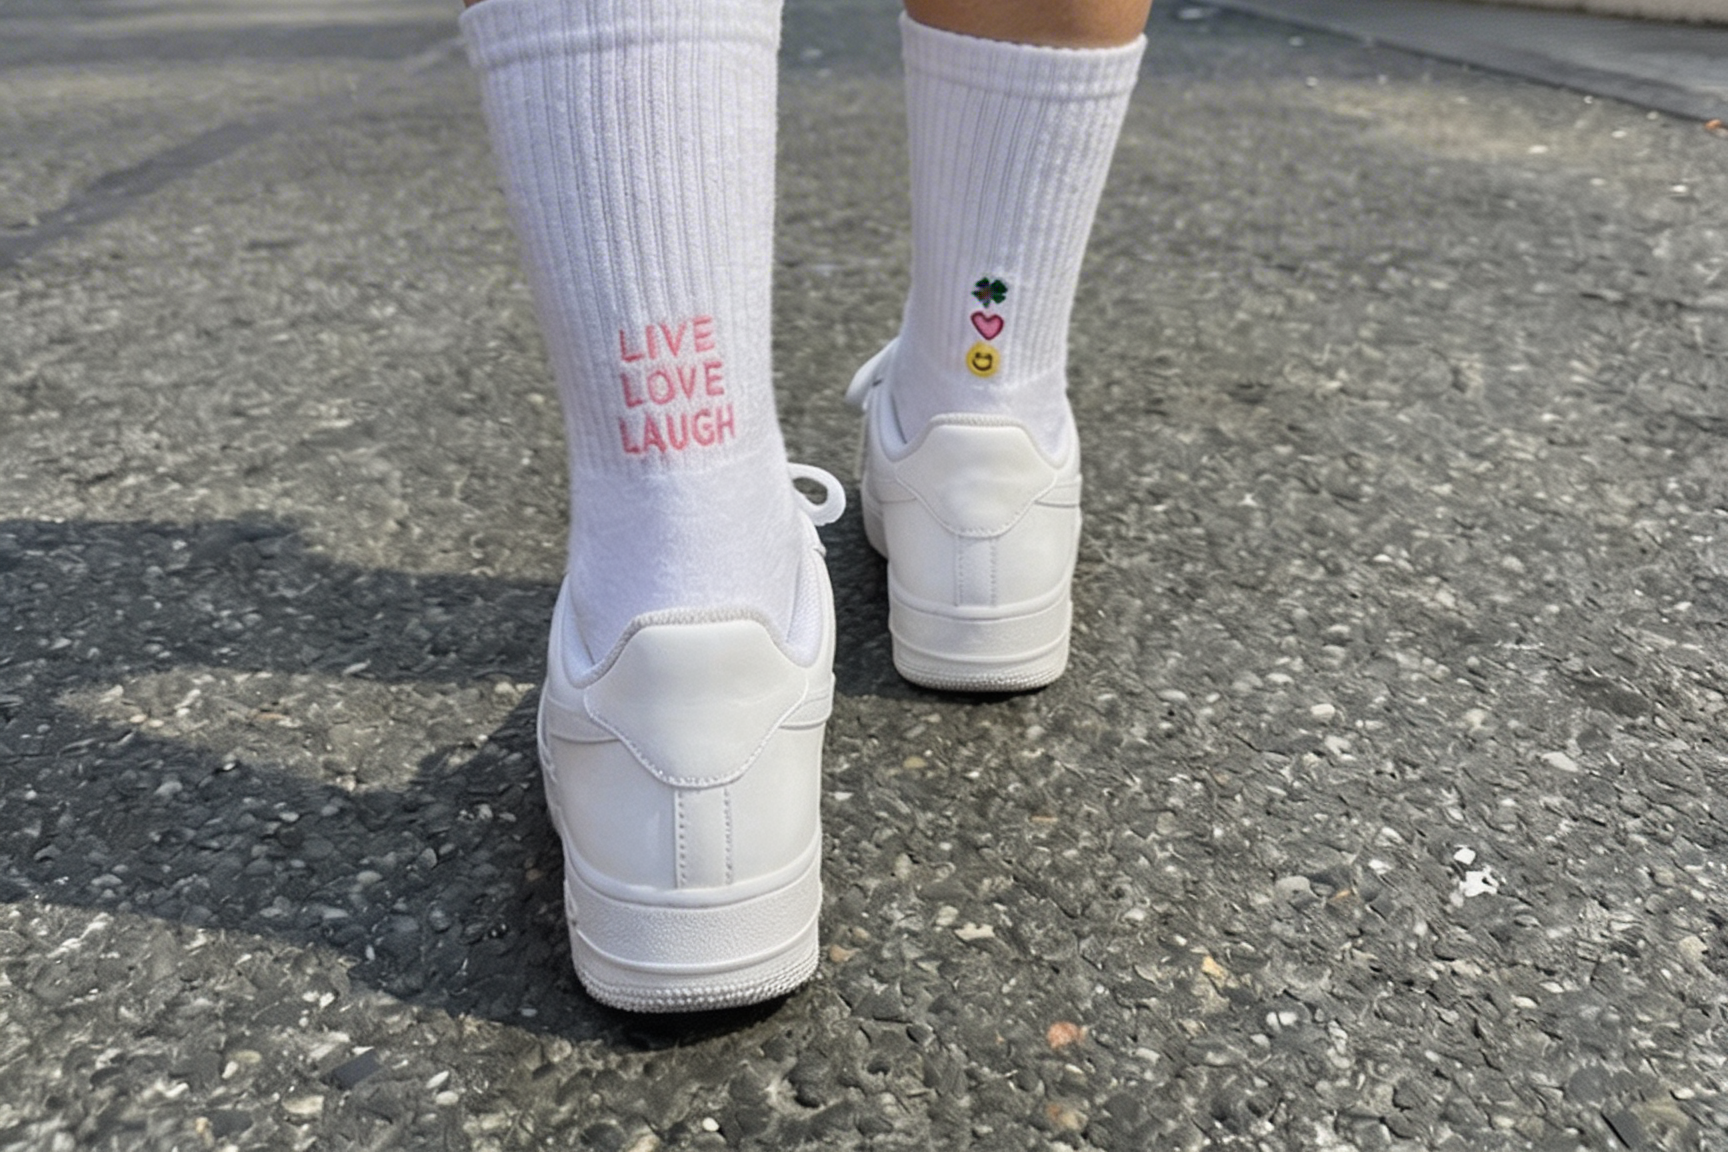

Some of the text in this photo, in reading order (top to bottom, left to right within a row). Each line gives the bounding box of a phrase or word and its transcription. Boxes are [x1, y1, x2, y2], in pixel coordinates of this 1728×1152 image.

[619, 315, 715, 362] LIVE
[620, 361, 724, 408] LOVE
[619, 404, 735, 454] LAUGH
